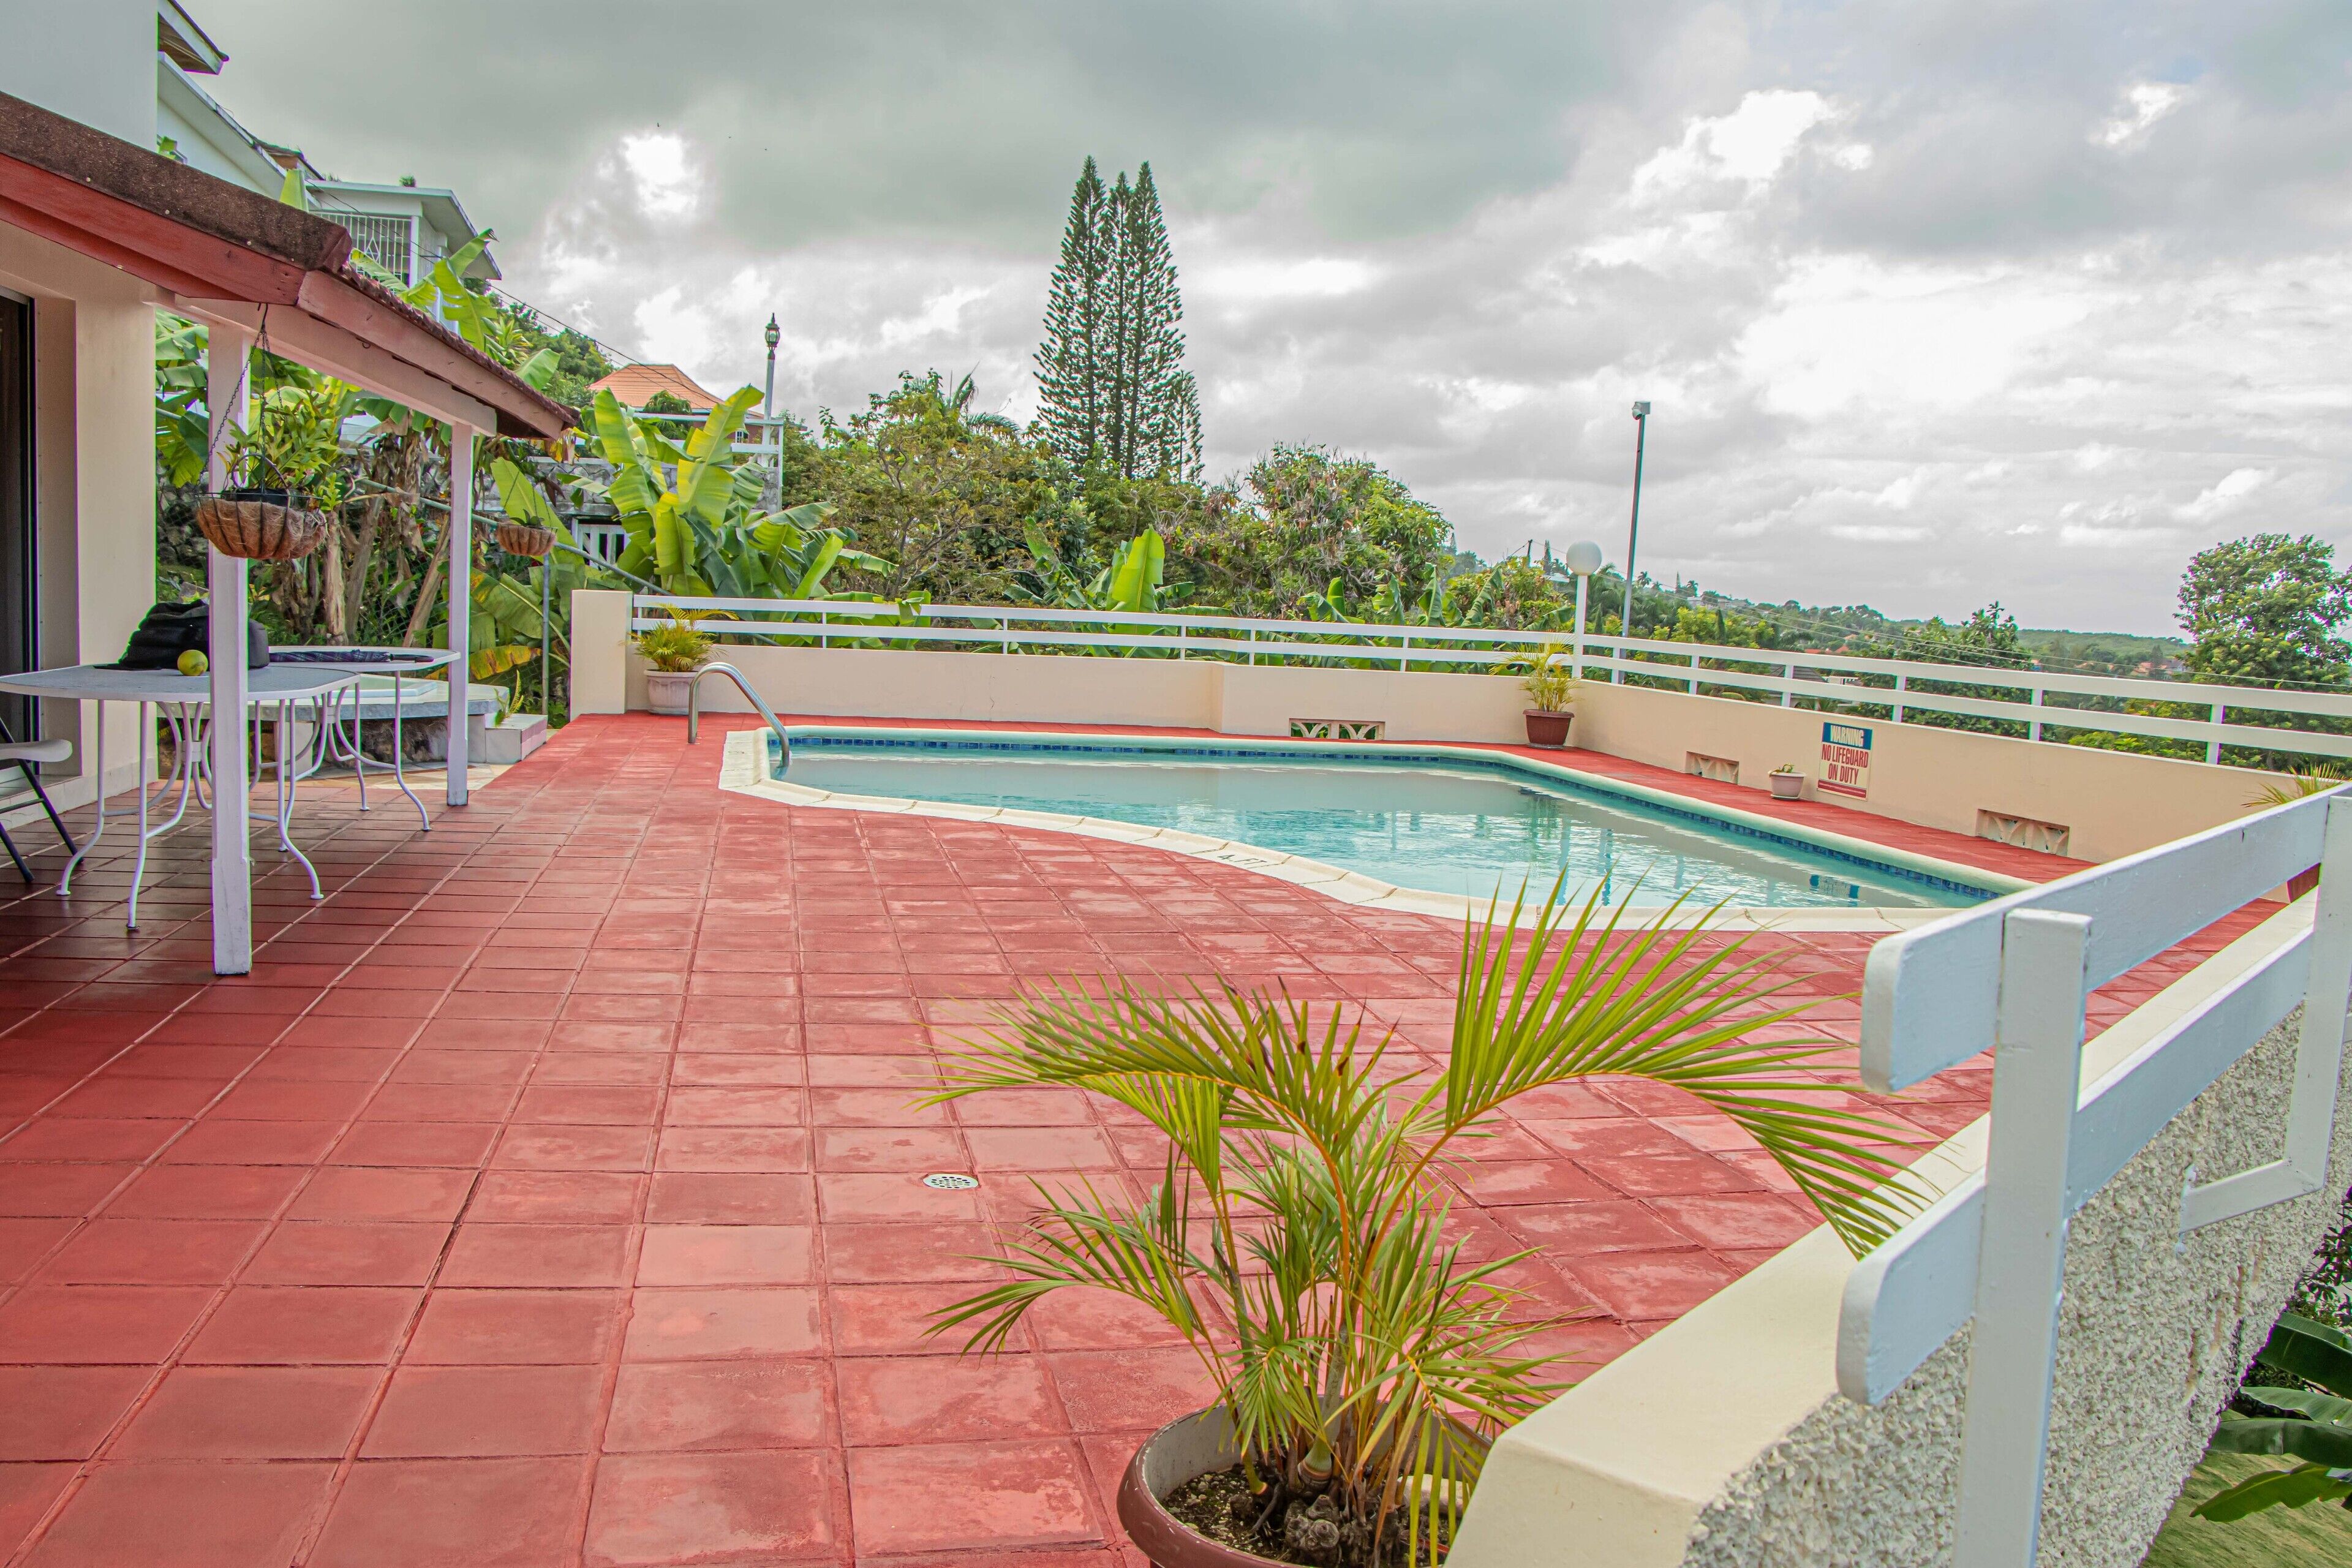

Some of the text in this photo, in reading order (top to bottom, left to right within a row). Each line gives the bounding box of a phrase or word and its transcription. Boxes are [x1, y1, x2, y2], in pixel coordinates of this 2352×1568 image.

[1831, 725, 1864, 747] WARNING
[1822, 744, 1869, 768] NO LIFEGUARD
[1828, 763, 1859, 785] ON DUTY
